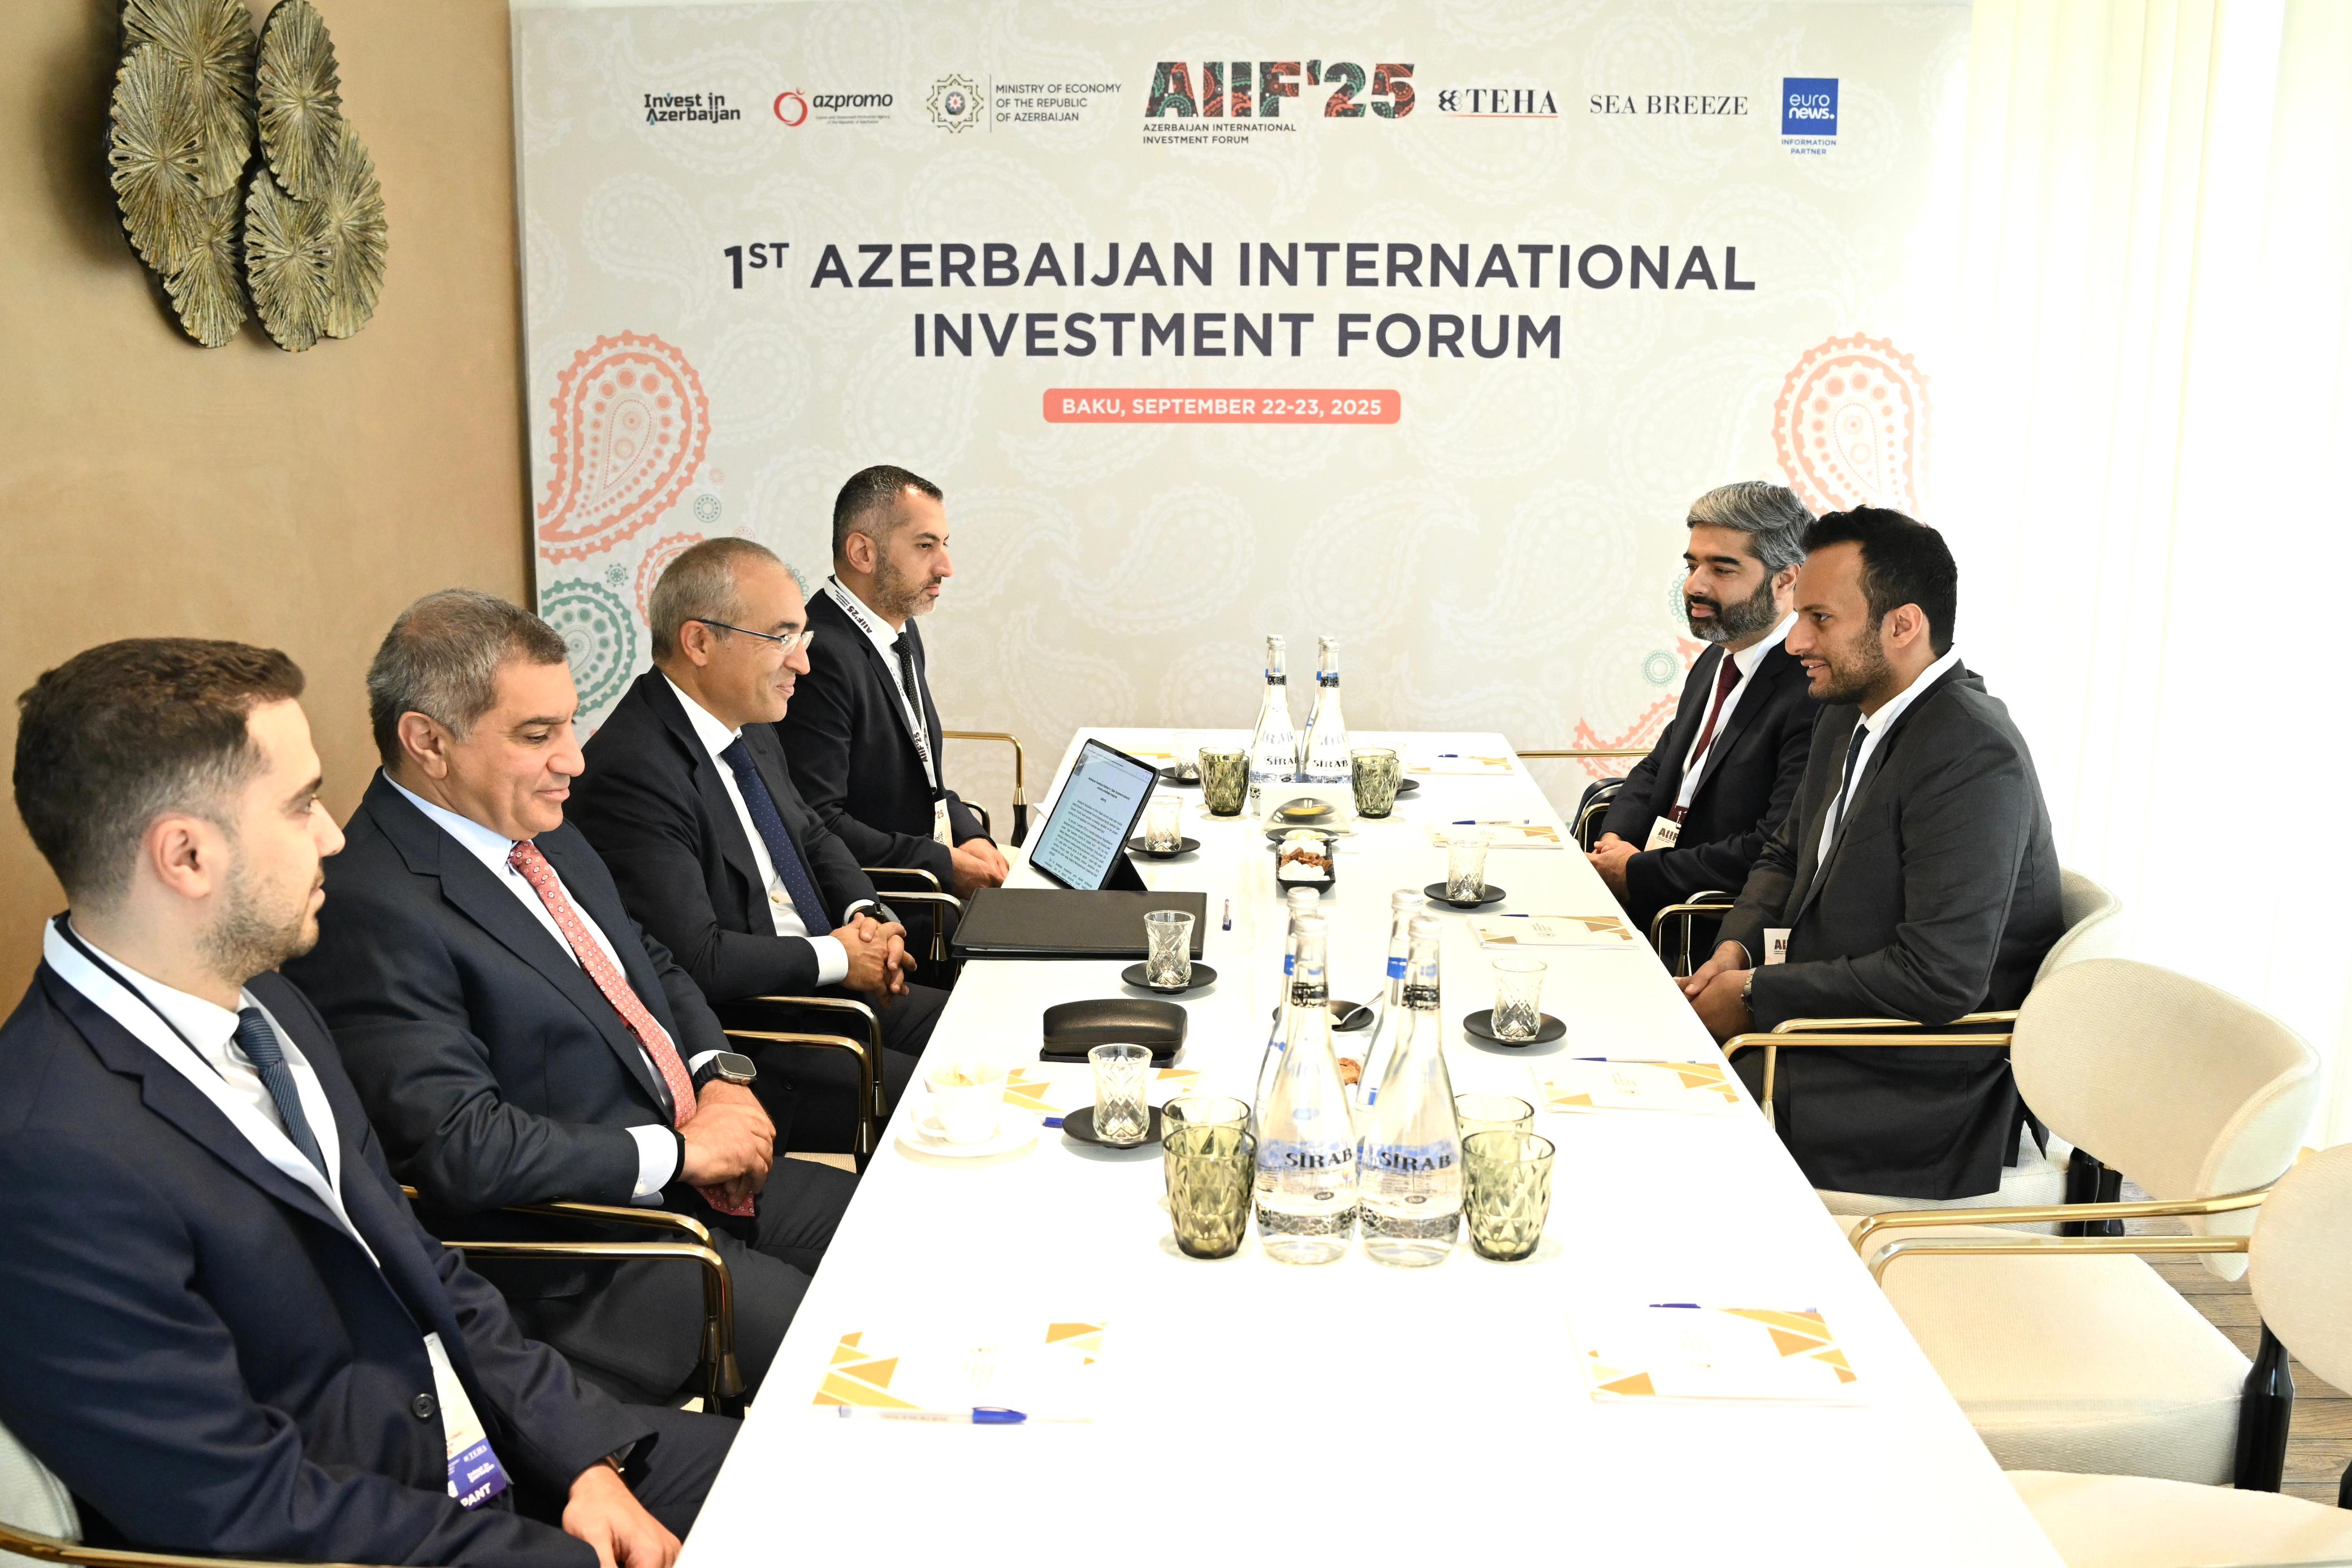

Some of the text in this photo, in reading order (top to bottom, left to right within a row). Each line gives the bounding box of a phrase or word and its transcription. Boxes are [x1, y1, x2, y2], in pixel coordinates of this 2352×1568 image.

[996, 83, 1122, 94] MINISTRY OF ECONOMY
[1144, 59, 1416, 119] AIIF'25
[644, 92, 725, 109] Invest in
[812, 94, 893, 112] azpromo
[996, 97, 1087, 108] OF THE REPUBLIC
[1465, 89, 1557, 114] TEHA
[1590, 95, 1748, 115] SEA BREEZE
[1789, 94, 1830, 107] euro
[646, 108, 741, 125] Azerbaijan
[996, 112, 1079, 122] OF AZERBAIJAN
[1788, 105, 1835, 120] news.
[1143, 123, 1296, 132] AZERBAIJAN INTERNATIONAL
[1143, 136, 1249, 144] INVESTMENT FORUM
[724, 242, 1756, 291] 1ST AZERBAIJAN INTERNATIONAL
[915, 312, 1561, 359] INVESTMENT FORUM
[1062, 398, 1381, 418] BAKU, SEPTEMBER 22-23, 2025
